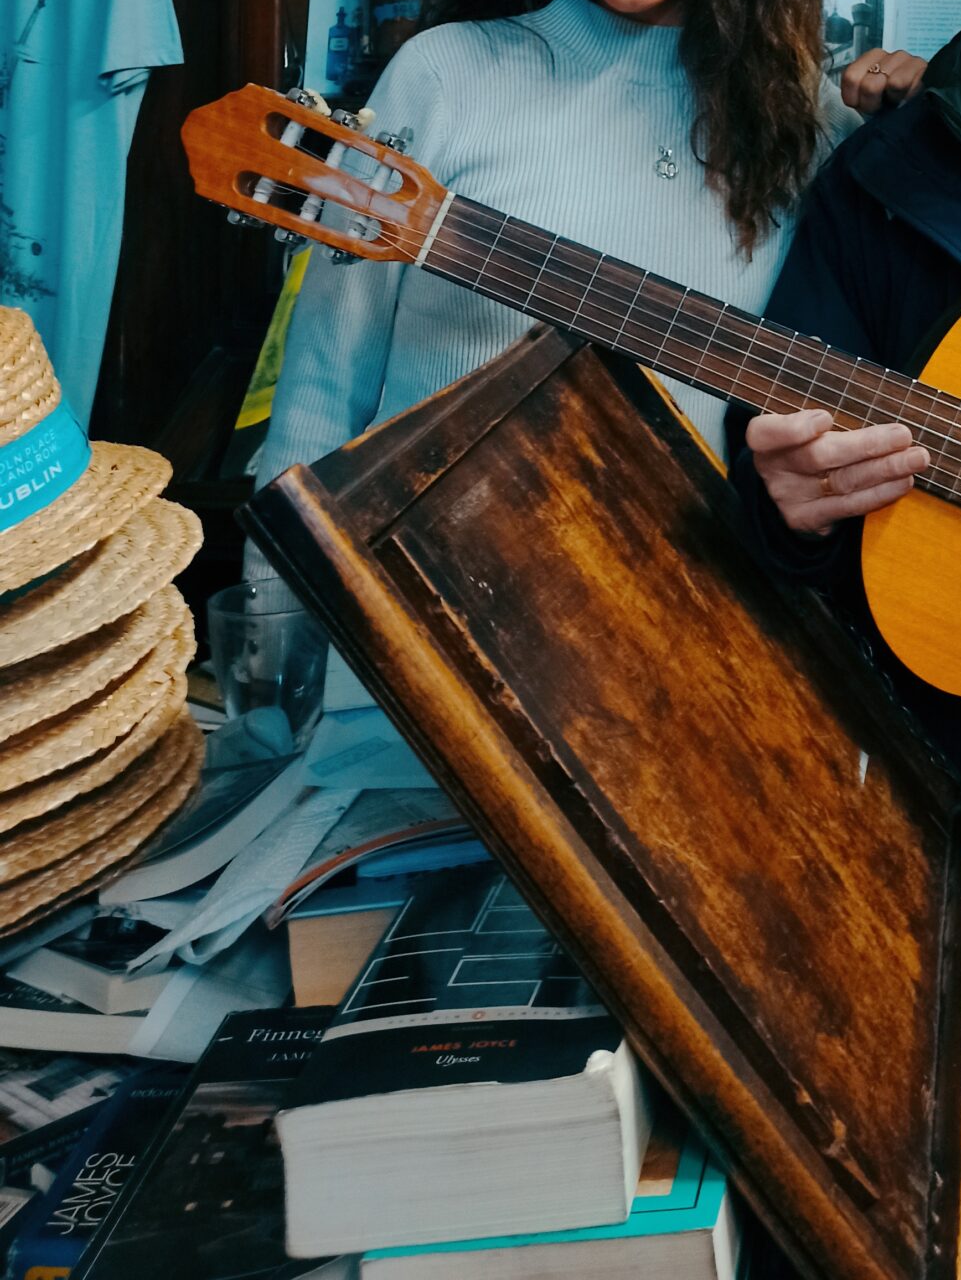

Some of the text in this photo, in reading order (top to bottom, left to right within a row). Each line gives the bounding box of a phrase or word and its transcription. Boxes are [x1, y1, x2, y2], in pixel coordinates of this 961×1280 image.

[25, 428, 56, 456] PLACE
[35, 442, 58, 464] ROW
[411, 1039, 518, 1053] JAMES JOYCE
[435, 1055, 482, 1067] Ulysses
[46, 1152, 119, 1235] JAMES
